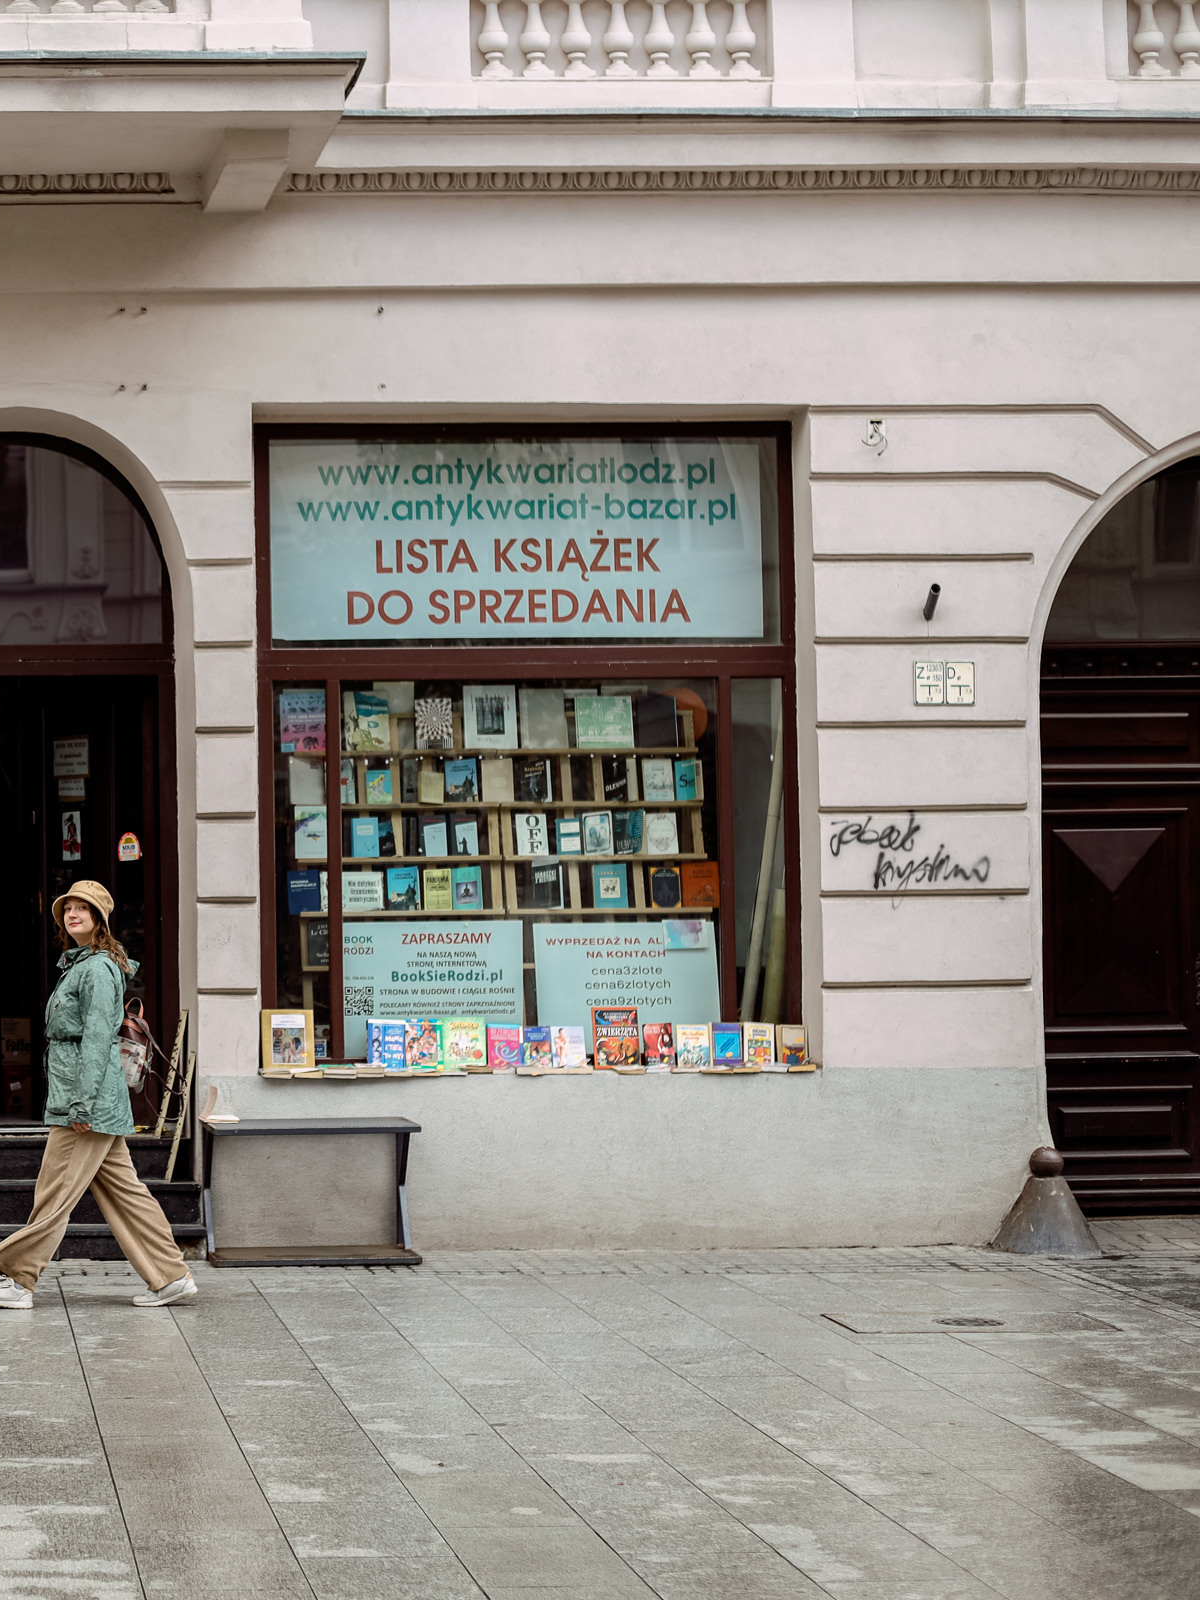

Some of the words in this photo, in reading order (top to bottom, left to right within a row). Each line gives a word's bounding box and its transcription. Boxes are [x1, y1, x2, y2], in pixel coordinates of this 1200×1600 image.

[318, 457, 716, 491] www.antykwariatlodz.pl
[297, 493, 737, 526] www.antykwariat-bazar.pl
[375, 538, 479, 575] LISTA
[494, 529, 662, 583] KSIĄŻEK
[346, 590, 414, 626] DO
[428, 588, 692, 625] SPRZEDANIA
[344, 936, 373, 944] BOOK
[401, 932, 492, 945] ZAPRASZAMY
[624, 937, 641, 945] NA
[344, 947, 374, 955] RODZI
[429, 951, 453, 959] NASZĄ
[454, 951, 477, 959] NOWĄ
[586, 951, 603, 959] NA
[606, 950, 666, 959] KONTACH
[407, 961, 435, 969] STRONĘ
[436, 960, 487, 968] INTERNETOWĄ
[391, 969, 503, 983] BookSieRodzi.pl
[462, 988, 488, 996] CIĄGLE
[489, 986, 515, 994] ROŚNIE
[596, 1026, 638, 1038] ZWIERZĘTA
